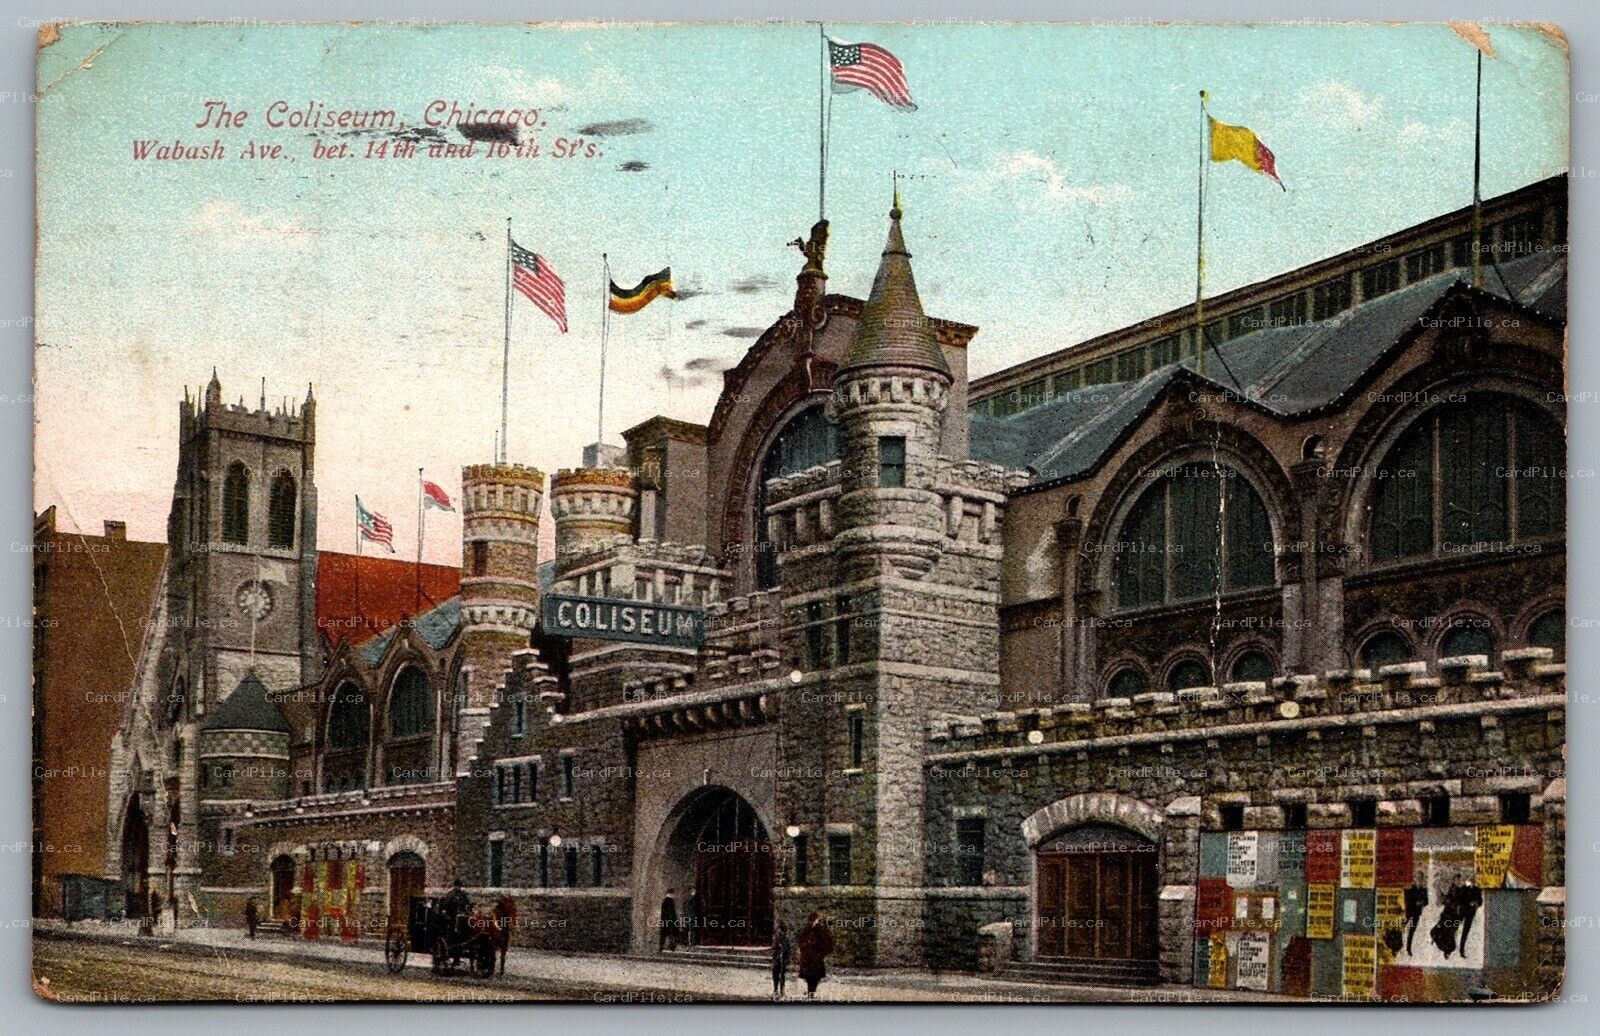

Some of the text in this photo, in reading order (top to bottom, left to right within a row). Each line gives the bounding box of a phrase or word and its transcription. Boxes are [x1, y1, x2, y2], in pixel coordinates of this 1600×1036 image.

[195, 100, 248, 129] The
[266, 100, 405, 132] Coliseum,
[132, 139, 225, 161] Wabash
[312, 139, 355, 160] bet.
[364, 139, 415, 159] 14th
[428, 138, 475, 159] and
[552, 137, 604, 159] St's.
[557, 600, 694, 638] COLISEUM
